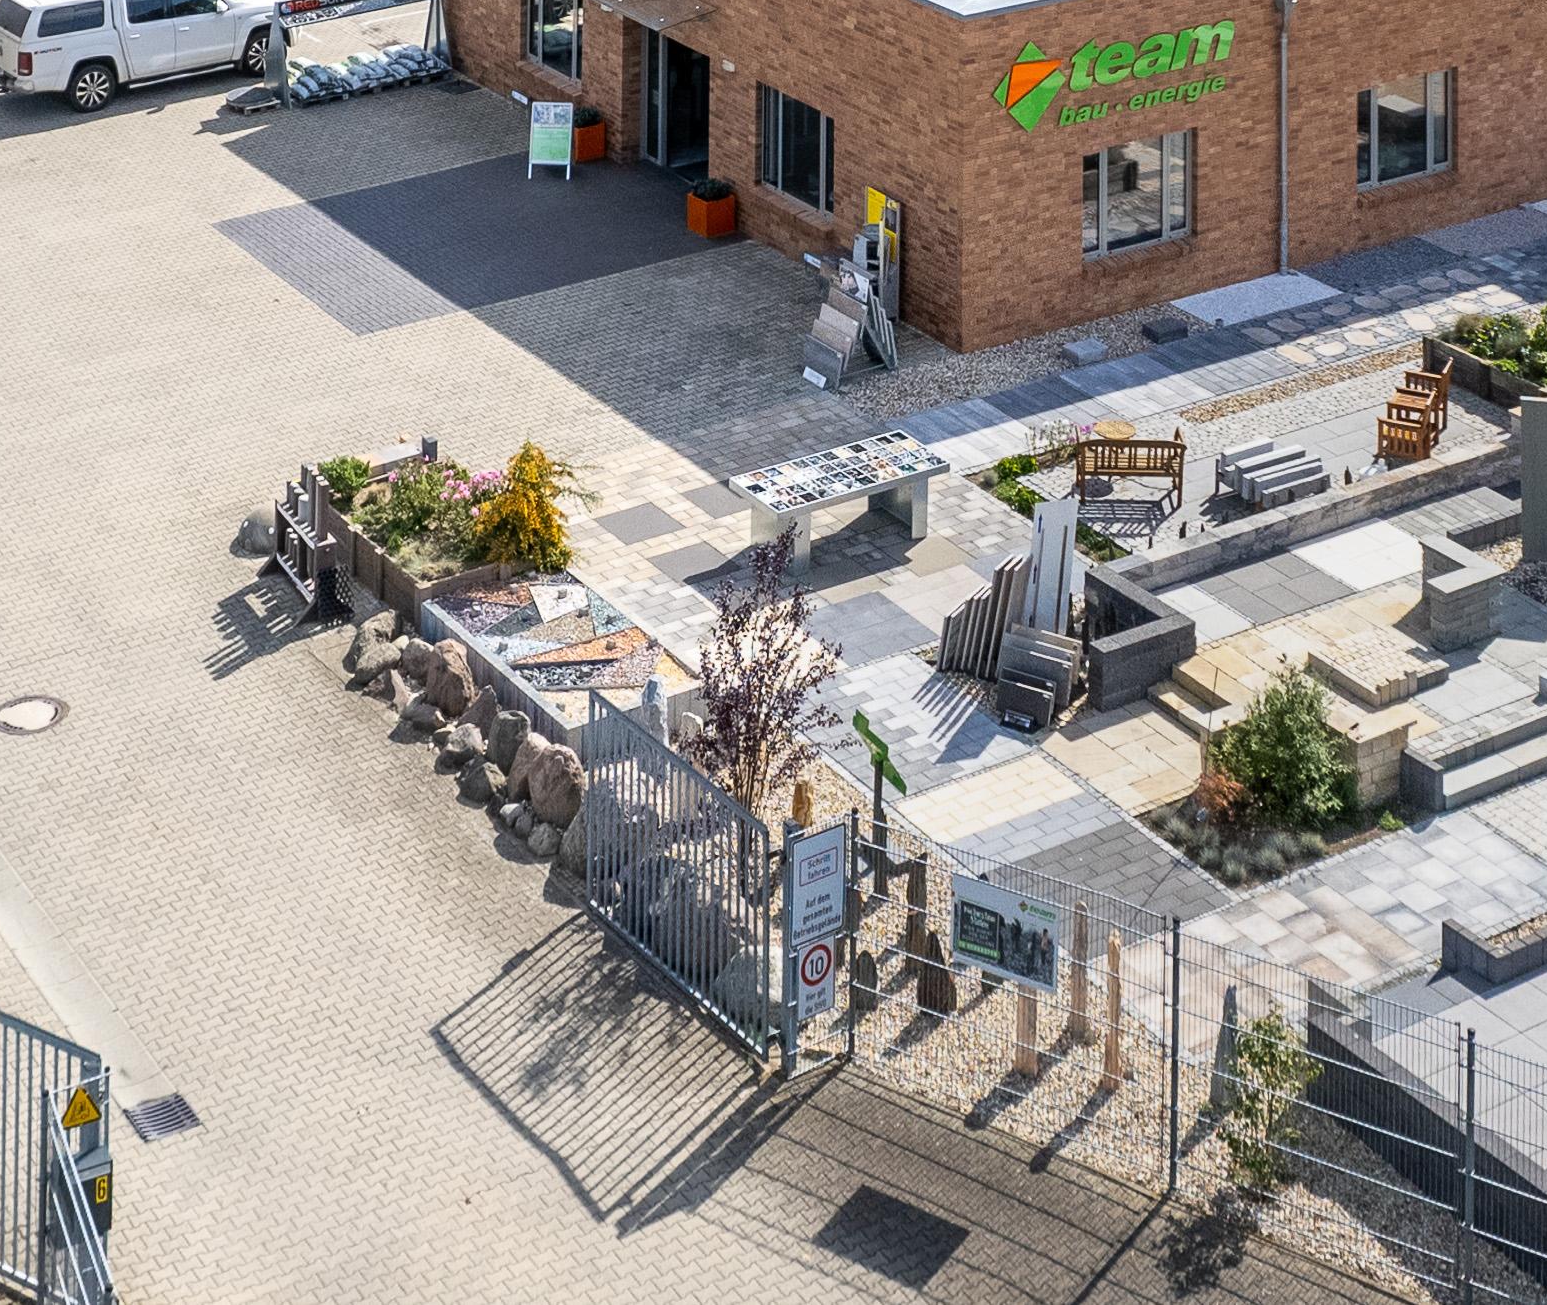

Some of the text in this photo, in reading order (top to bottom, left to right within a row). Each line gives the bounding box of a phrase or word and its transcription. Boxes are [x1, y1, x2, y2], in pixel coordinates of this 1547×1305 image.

[1068, 18, 1236, 92] team
[1058, 102, 1110, 127] bau
[1127, 73, 1227, 111] energie
[806, 853, 831, 870] Schritt
[807, 866, 831, 880] fahren
[805, 893, 831, 909] Auf dem
[802, 905, 833, 925] gesamten
[793, 913, 841, 941] Betriebsgelände
[809, 956, 824, 978] 10
